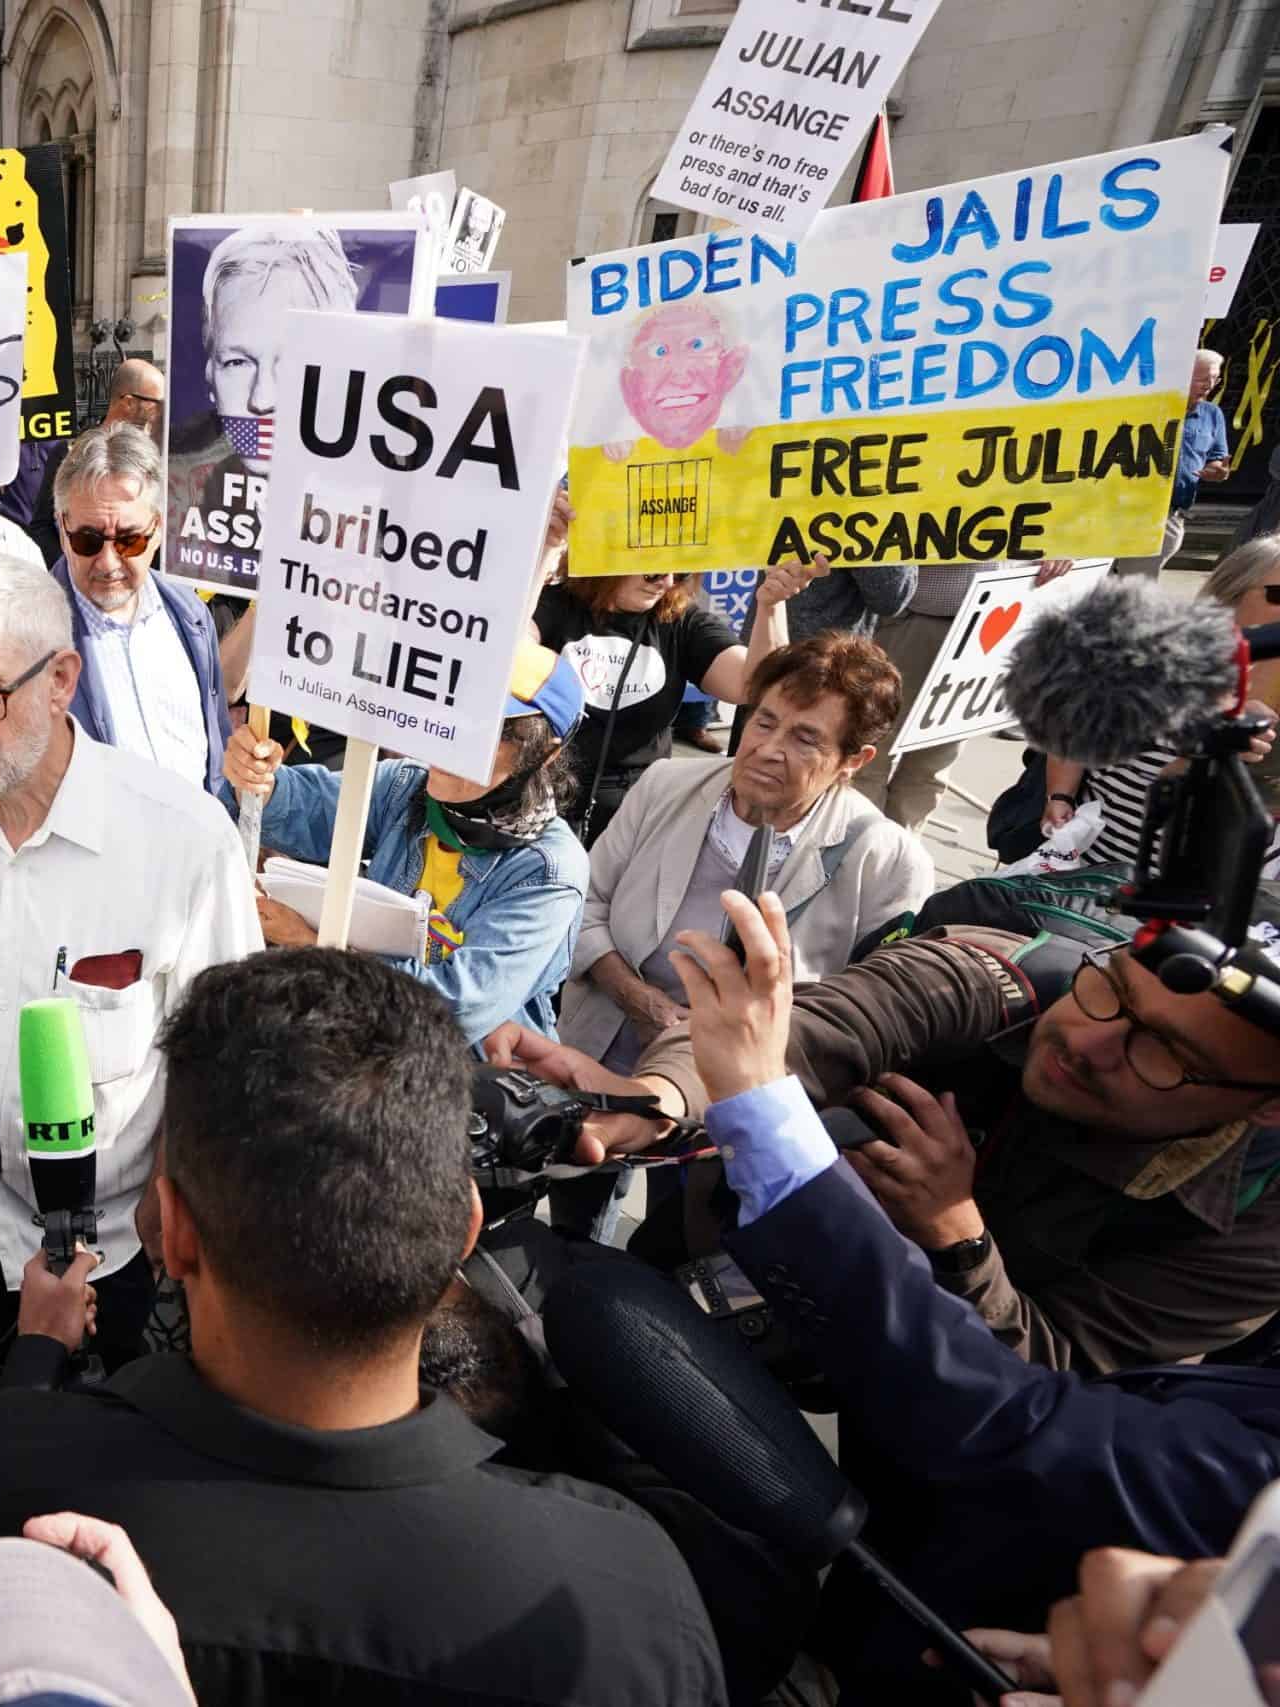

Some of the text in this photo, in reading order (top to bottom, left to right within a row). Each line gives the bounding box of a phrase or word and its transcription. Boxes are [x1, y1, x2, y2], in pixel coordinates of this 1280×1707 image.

[739, 29, 881, 89] JULIAN
[712, 86, 851, 142] ASSANGE
[679, 152, 811, 203] press and that's
[689, 129, 829, 181] or there's no free
[680, 176, 785, 222] bad for us all.
[892, 158, 1161, 263] JAILS
[591, 232, 796, 316] BIDEN
[785, 260, 1054, 353] PRESS
[780, 317, 1155, 420] FREEDOM
[299, 364, 520, 491] USA
[769, 417, 1180, 499] FREE JULIAN
[223, 472, 268, 511] FR
[640, 496, 697, 517] ASSANGE
[181, 547, 203, 566] NO
[207, 552, 238, 572] U.S.
[300, 492, 488, 581] bribed
[766, 501, 1053, 566] ASSANGE
[280, 558, 490, 642] Thordarson
[952, 590, 991, 660] i
[286, 615, 462, 706] to LIE!
[279, 670, 457, 741] In Julian Assange trial
[920, 673, 1007, 730] tru
[27, 1113, 95, 1141] RT R
